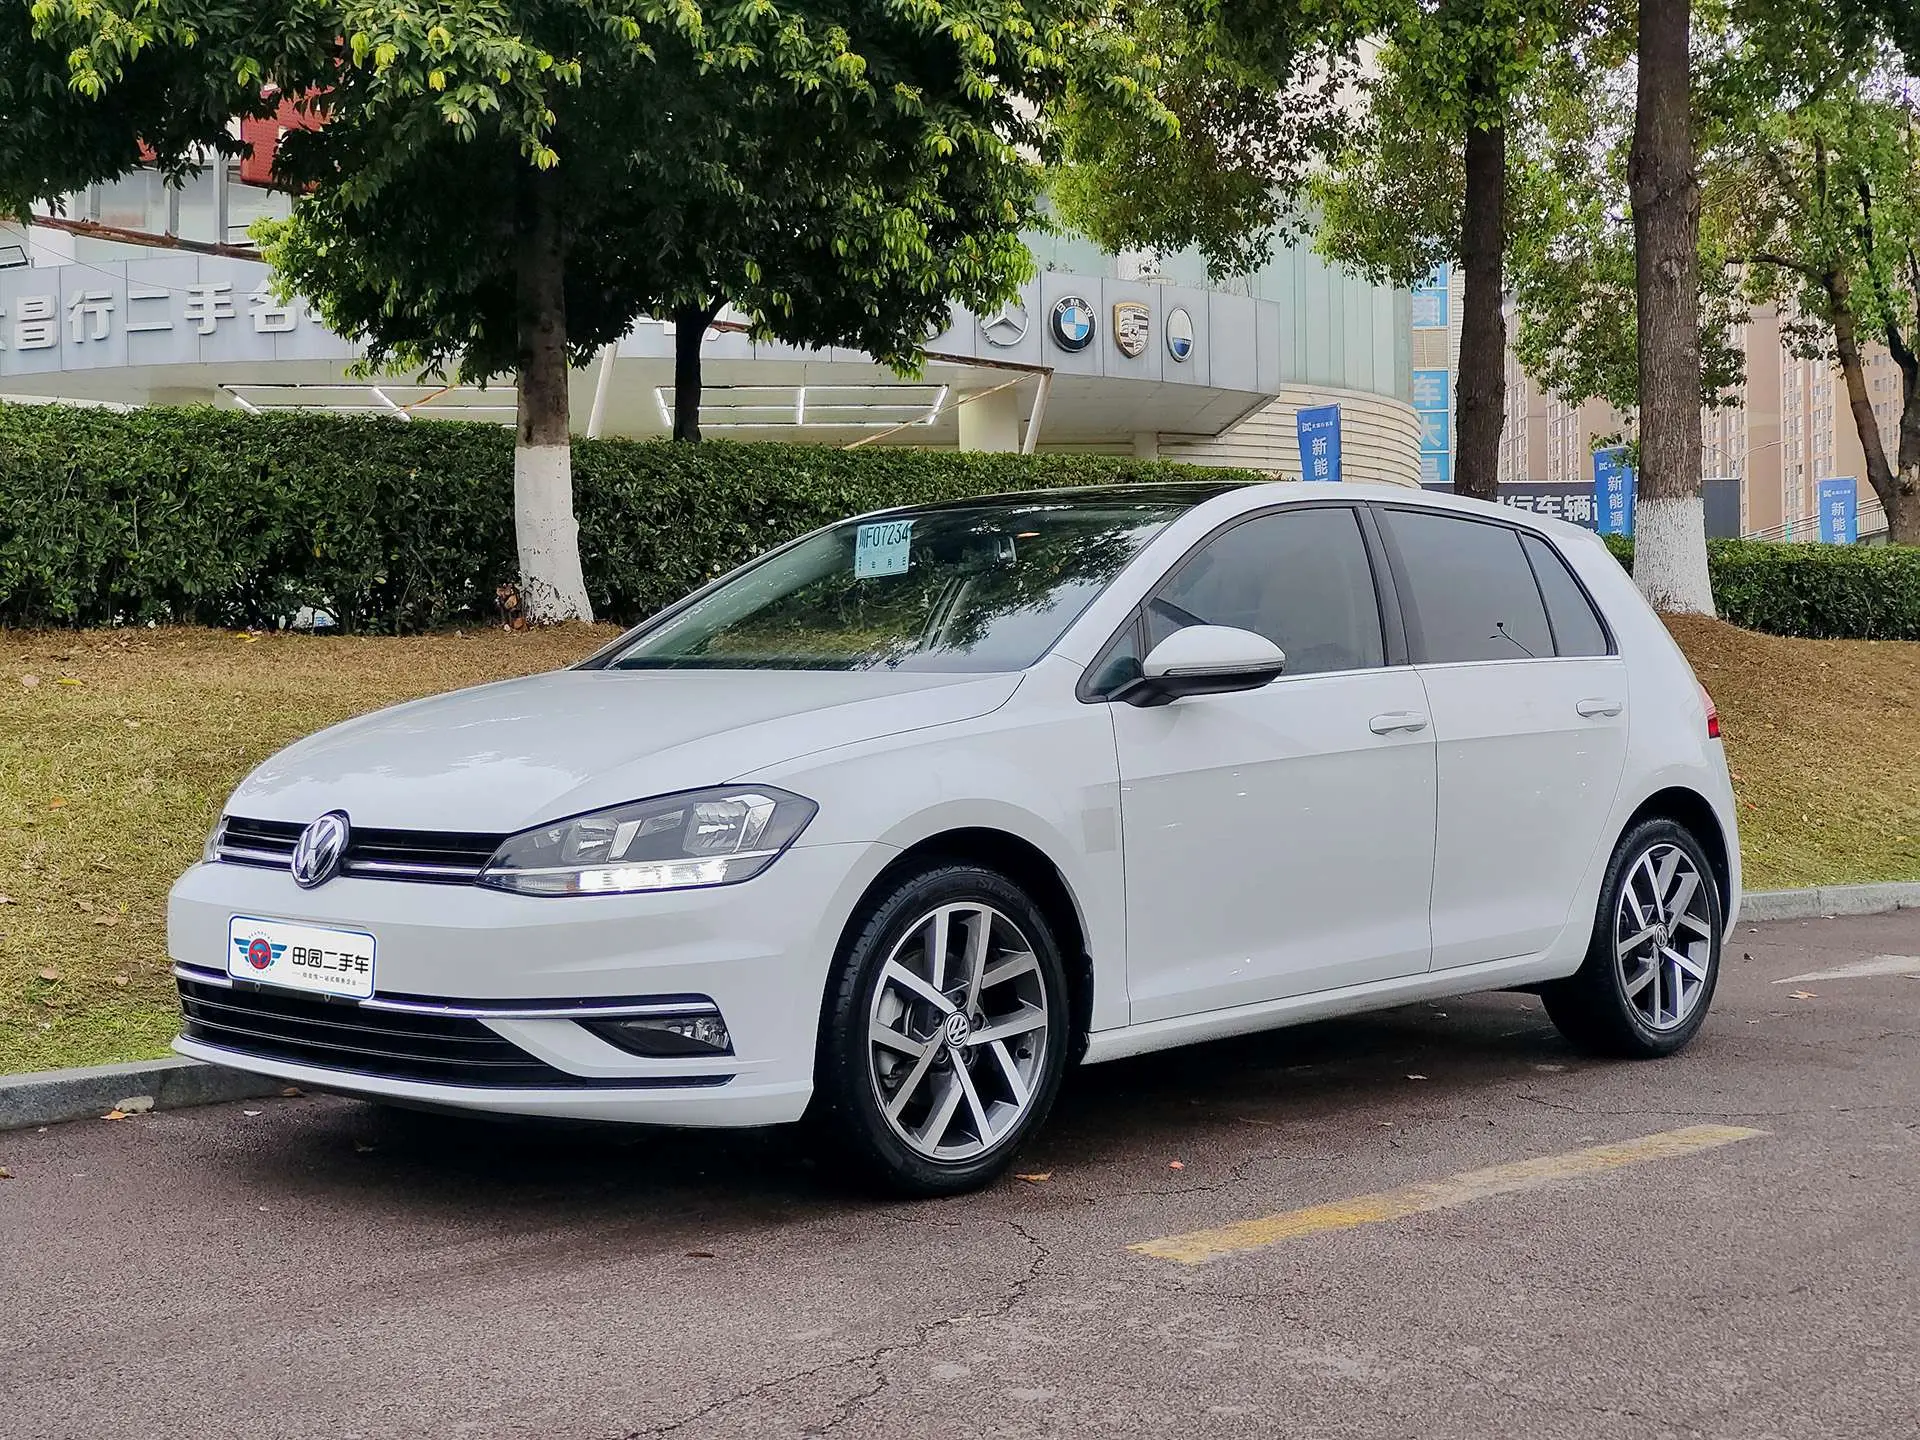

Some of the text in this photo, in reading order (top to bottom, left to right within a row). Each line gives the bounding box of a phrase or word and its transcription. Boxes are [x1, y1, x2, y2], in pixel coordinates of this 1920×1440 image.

[0, 281, 326, 351] 昌行二手名
[1057, 299, 1093, 317] BMW
[1312, 437, 1328, 480] 新能
[1497, 493, 1598, 521] 行车辆
[292, 946, 369, 974] 田园二手车
